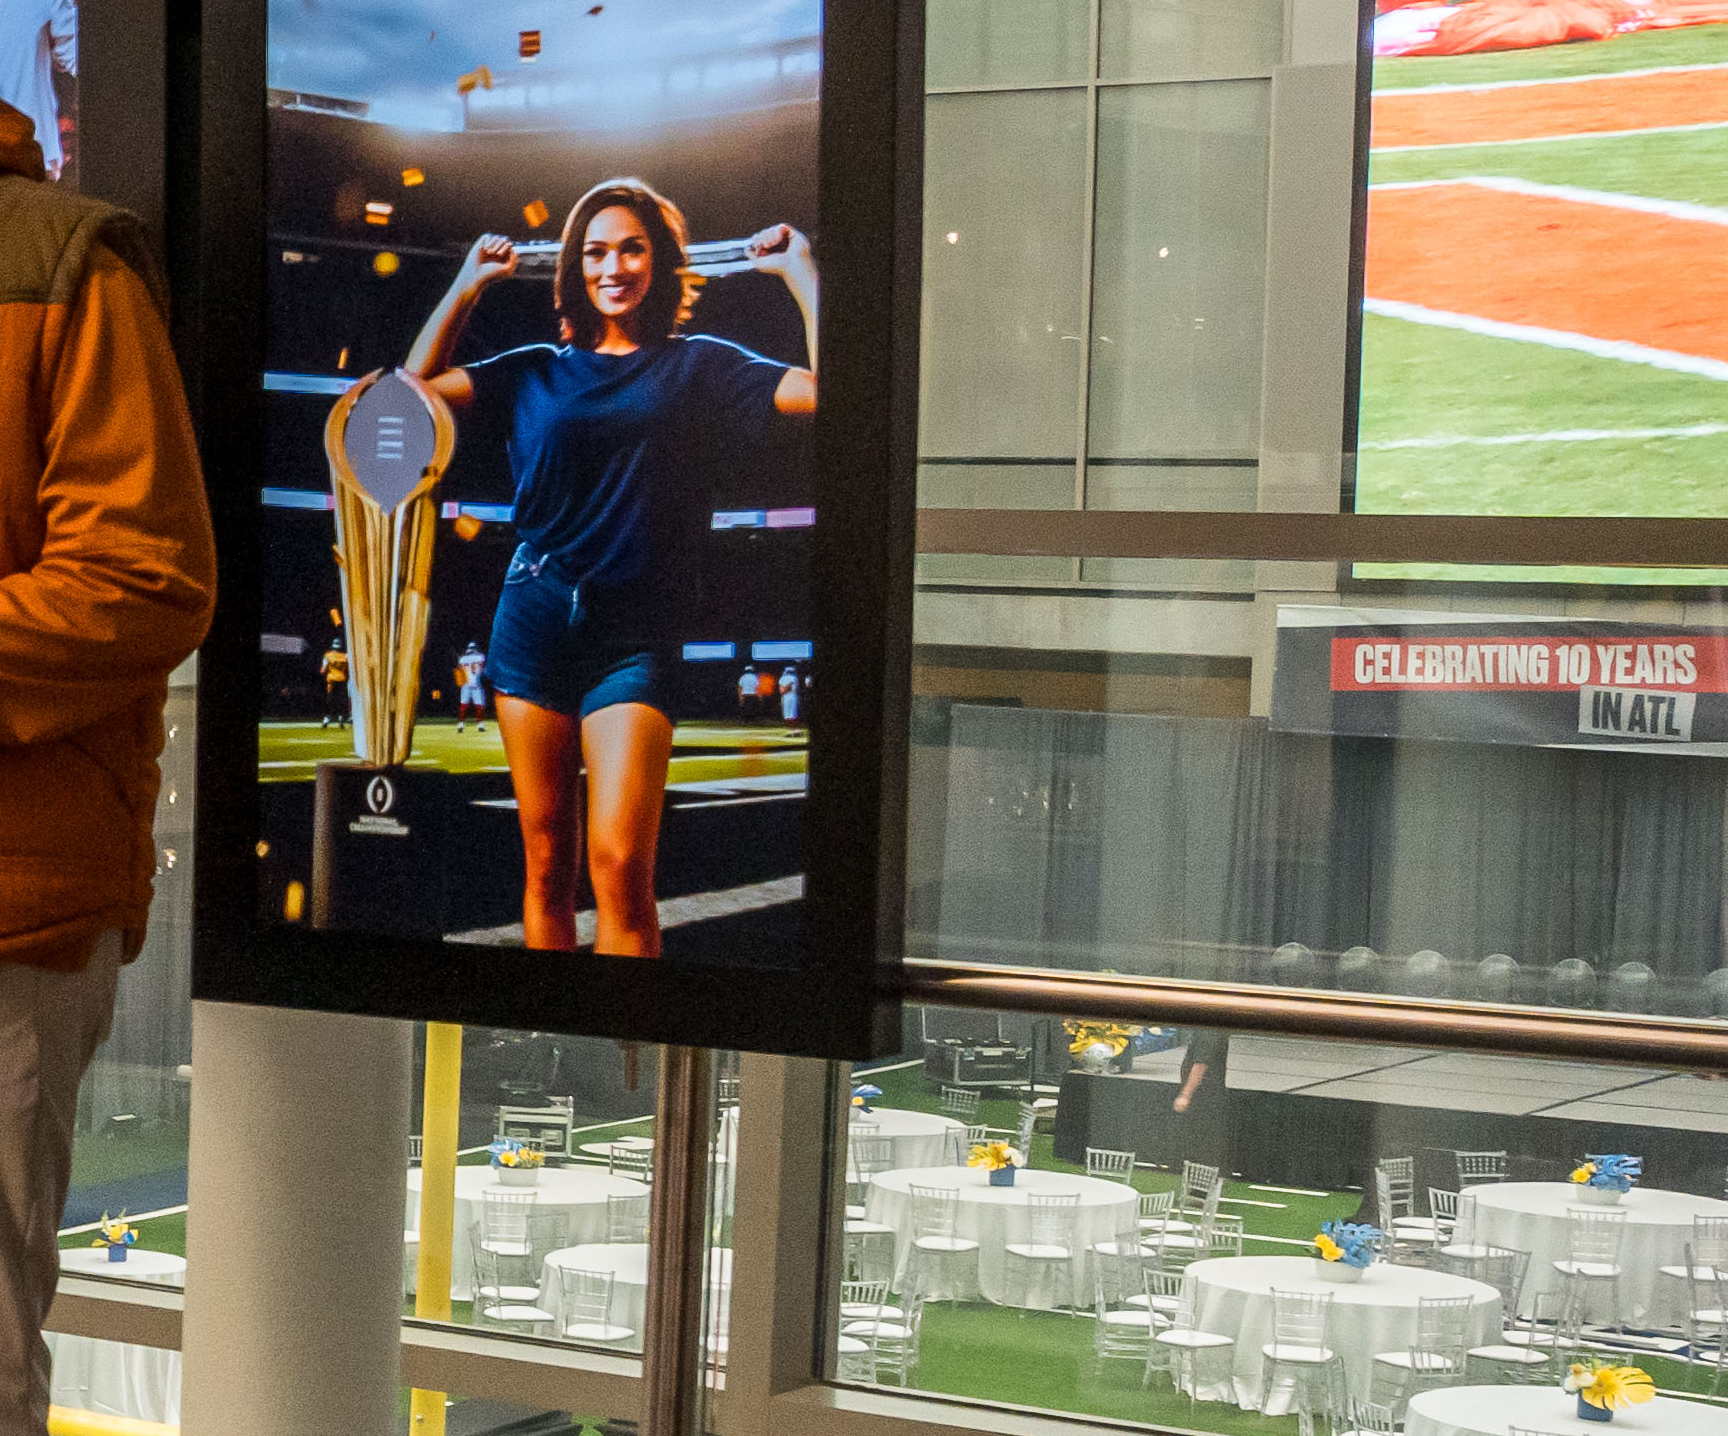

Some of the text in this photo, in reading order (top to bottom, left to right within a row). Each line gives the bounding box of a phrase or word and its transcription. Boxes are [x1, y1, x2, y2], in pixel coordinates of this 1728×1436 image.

[1353, 643, 1697, 685] CELEBRATING 10 YEARS
[1590, 690, 1680, 736] IN ATL
